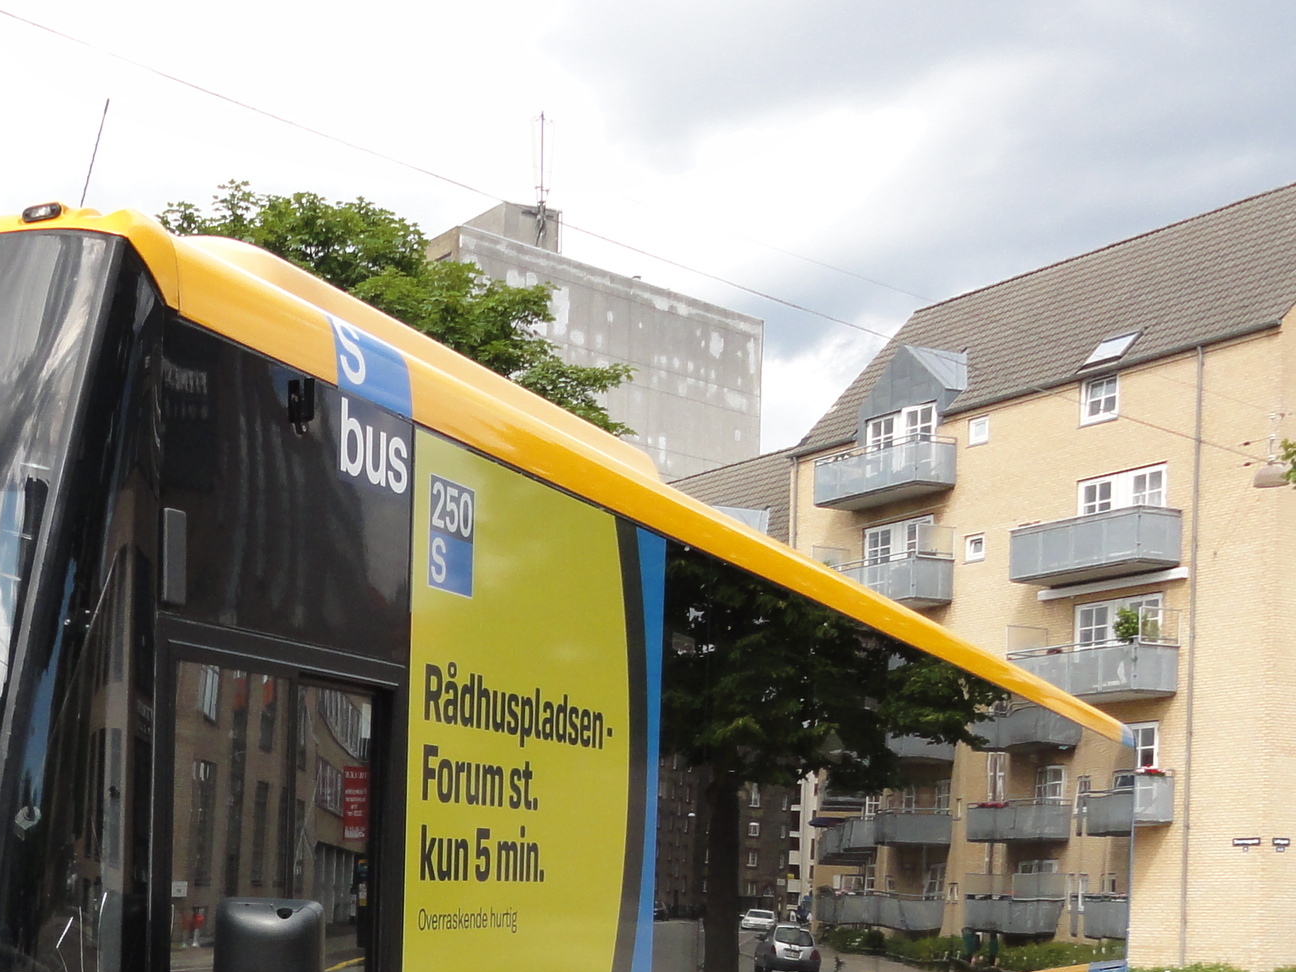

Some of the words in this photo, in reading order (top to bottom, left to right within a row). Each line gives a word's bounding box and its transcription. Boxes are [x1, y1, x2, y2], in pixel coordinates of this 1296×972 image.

[332, 317, 366, 386] S
[339, 397, 408, 494] bus
[431, 481, 473, 538] 250
[430, 537, 448, 584] S
[421, 744, 505, 808] Forum
[509, 760, 539, 811] st.
[419, 824, 469, 882] kun
[475, 828, 491, 881] 5
[497, 826, 545, 883] min.
[417, 908, 488, 932] Overraskende
[490, 907, 518, 934] hurtig
